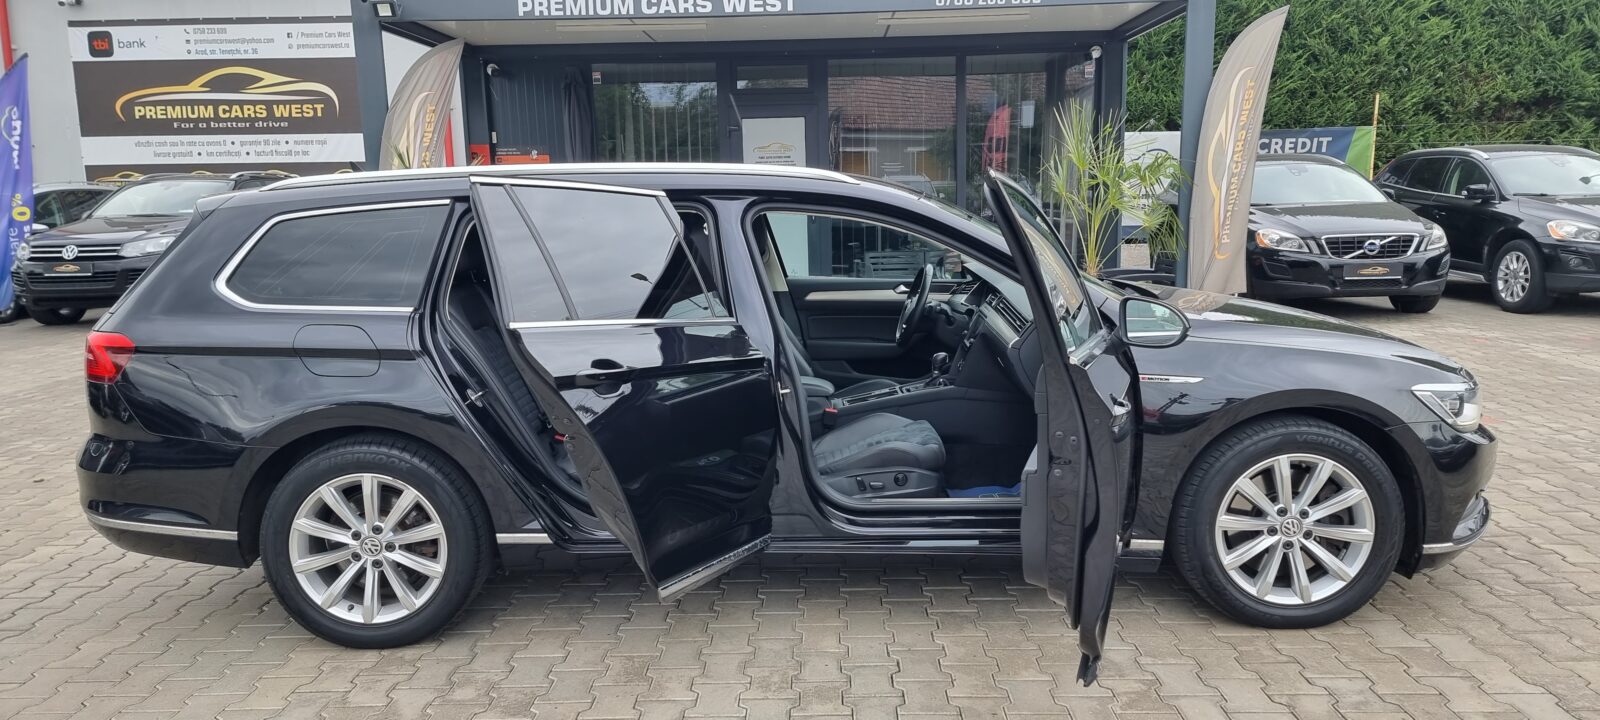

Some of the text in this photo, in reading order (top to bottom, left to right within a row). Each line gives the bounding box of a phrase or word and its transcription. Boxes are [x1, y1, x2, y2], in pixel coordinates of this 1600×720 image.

[518, 0, 796, 16] PREMIUM CARS WEST
[300, 31, 324, 39] Premium
[92, 38, 147, 50] tbi bank
[194, 37, 275, 46] premiumcarswest@yahoo.com
[296, 42, 350, 50] premiumcarswest.ro
[134, 103, 325, 120] PREMIUM CARS WEST
[173, 120, 289, 129] For a better drive
[155, 140, 168, 148] cash
[271, 138, 281, 146] zile
[1257, 136, 1333, 154] CREDIT
[153, 150, 171, 158] livrare
[1221, 176, 1240, 243] PREMIUM
[1231, 130, 1247, 173] CARS
[1239, 79, 1256, 126] WEST
[11, 193, 31, 222] 0%
